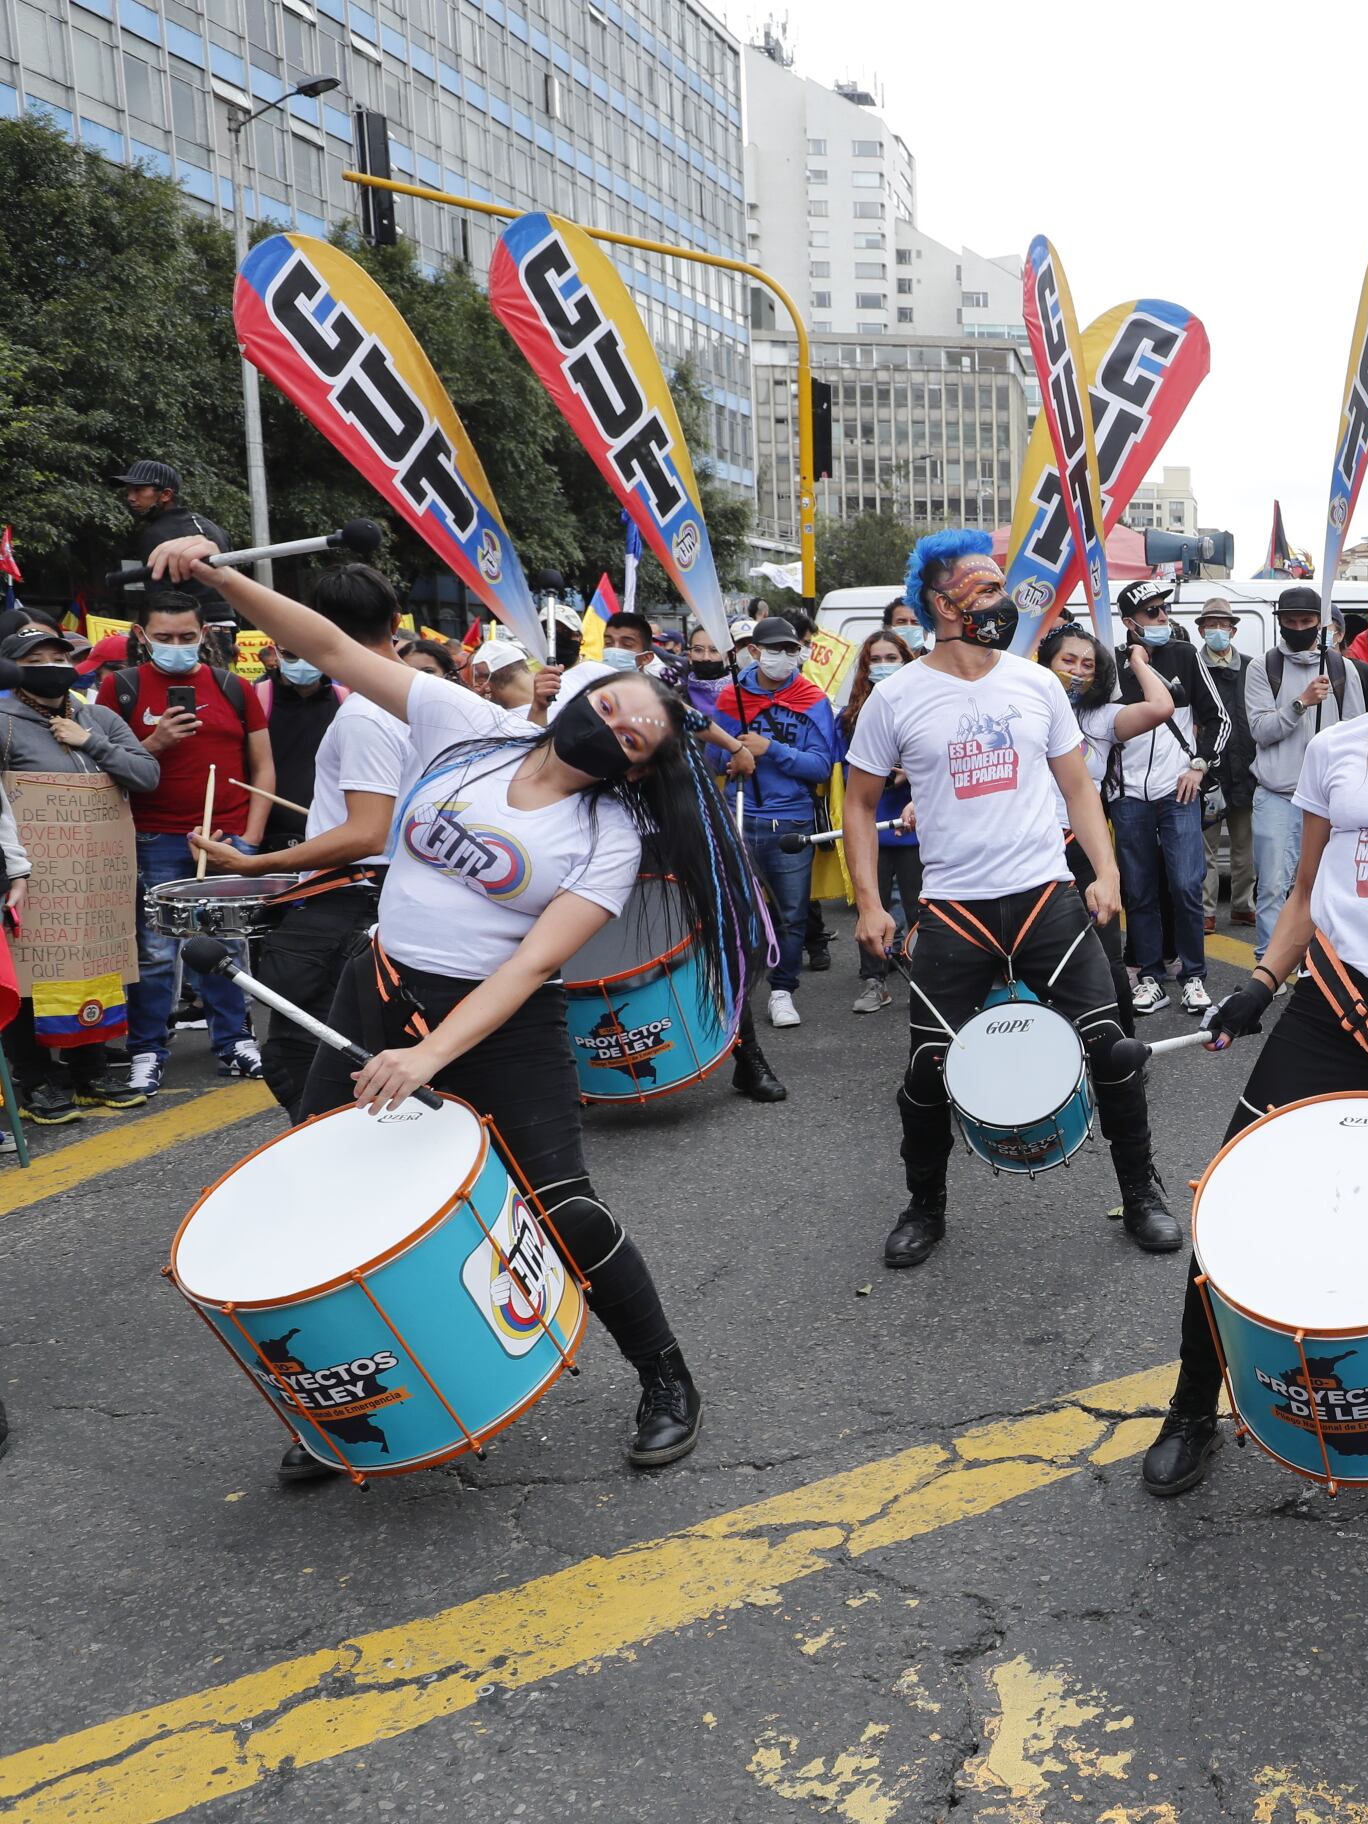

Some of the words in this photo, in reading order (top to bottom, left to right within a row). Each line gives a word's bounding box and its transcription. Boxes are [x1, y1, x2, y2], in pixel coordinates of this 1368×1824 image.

[519, 231, 687, 525] CUT
[266, 251, 478, 541] CUT
[1036, 255, 1096, 549] CUT
[949, 743, 965, 758] ES
[966, 740, 979, 756] EL
[950, 749, 1014, 774] MOMENTO
[954, 771, 971, 788] DE
[972, 763, 1013, 785] PARAR
[46, 794, 108, 807] REALIDAD
[23, 808, 48, 822] DE
[56, 806, 120, 823] NUESTROS
[18, 823, 94, 841] ÓVENES
[72, 860, 98, 875] DEL
[26, 877, 96, 894] PORQUE
[99, 876, 112, 891] NO
[115, 874, 133, 890] HAY
[23, 891, 132, 911] PORTUNIDADES.
[40, 909, 117, 926] PREFIEREN
[15, 926, 97, 943] RABAJAR
[32, 963, 65, 978] QUE
[574, 1017, 673, 1048] PROYECTOS
[985, 1019, 1034, 1035] GOPE
[598, 1048, 622, 1059] DE
[626, 1036, 655, 1055] LEY
[256, 1351, 398, 1391] PROYECTOS
[280, 1390, 315, 1407] DE
[314, 1381, 366, 1406] LEY
[346, 1392, 402, 1414] Emergencia
[1291, 1401, 1328, 1420] DE
